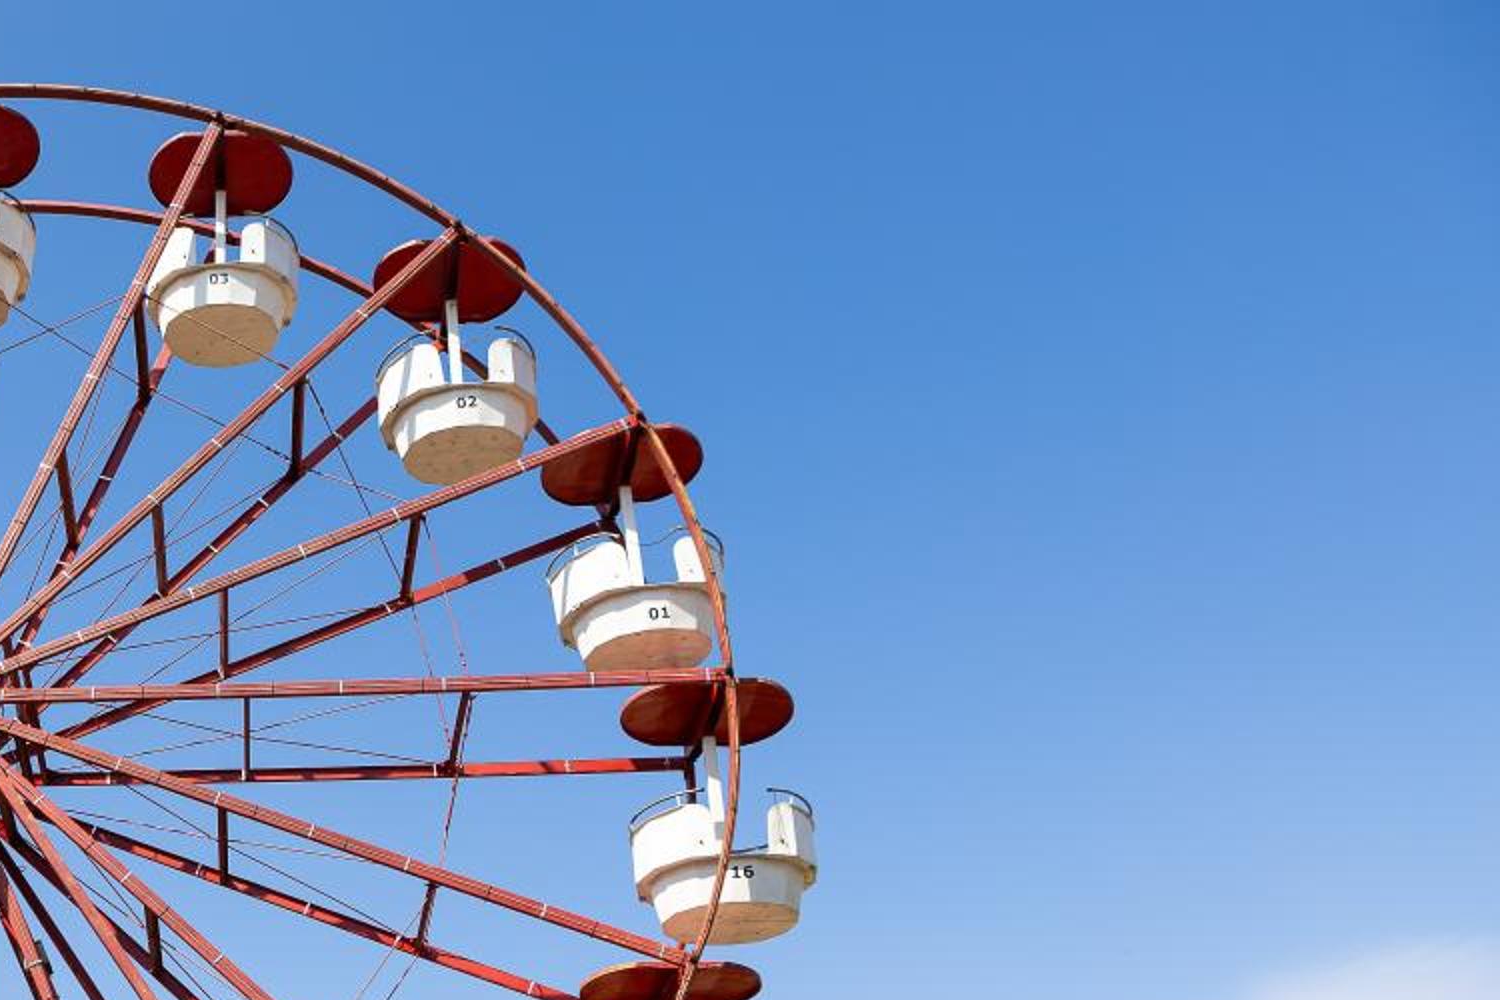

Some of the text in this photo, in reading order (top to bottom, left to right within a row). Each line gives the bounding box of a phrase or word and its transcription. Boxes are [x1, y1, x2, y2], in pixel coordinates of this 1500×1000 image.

[209, 273, 229, 284] 03
[457, 396, 477, 408] 02
[649, 608, 671, 619] 01
[732, 866, 754, 879] 16
